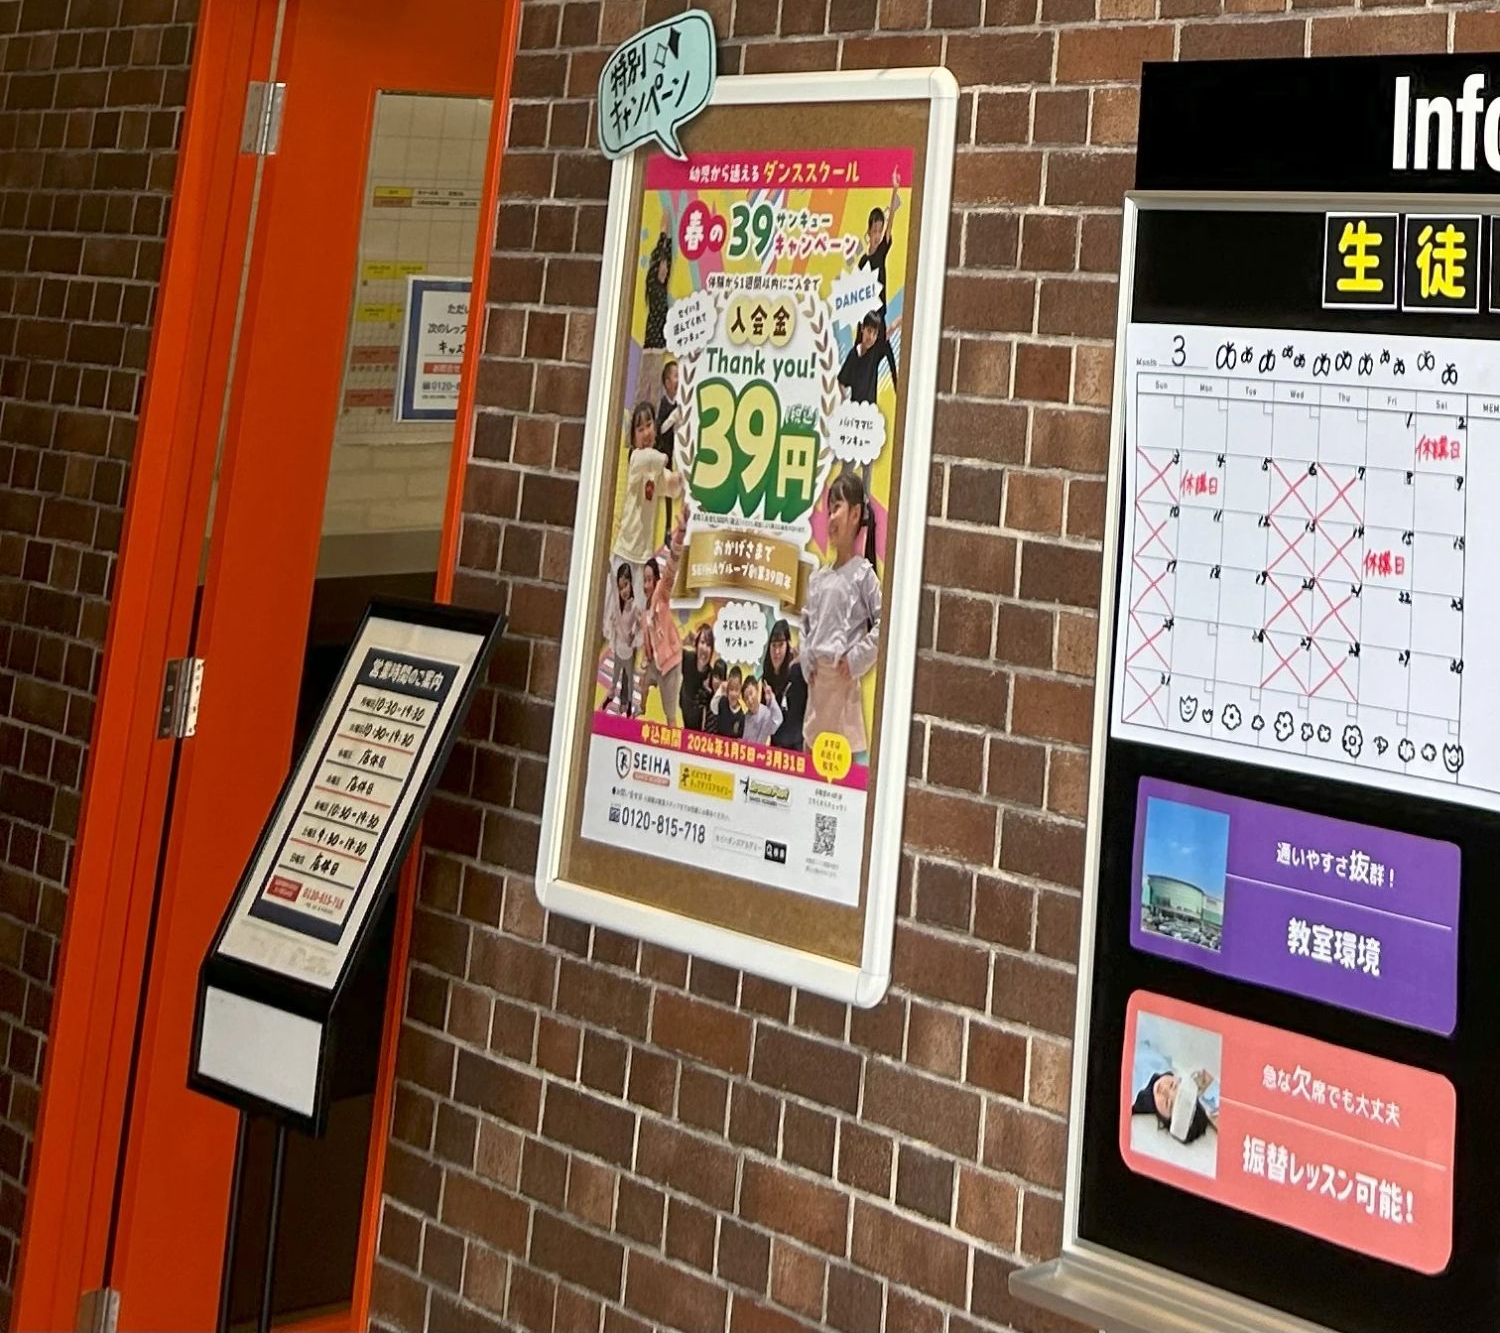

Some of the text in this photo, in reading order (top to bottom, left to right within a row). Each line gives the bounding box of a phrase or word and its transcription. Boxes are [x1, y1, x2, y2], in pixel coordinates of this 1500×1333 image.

[610, 42, 647, 99] 特別
[609, 70, 691, 141] キャンペーン
[762, 160, 860, 184] ダンススクール
[728, 204, 774, 258] 39
[773, 235, 858, 257] キャンペーン
[835, 284, 876, 311] DANCE!
[730, 304, 791, 337] 入会金
[706, 347, 817, 383] Thank you!
[1171, 334, 1187, 368] 3
[1457, 416, 1467, 431] 2
[632, 751, 672, 777] SEIHA
[621, 806, 706, 844] 0120-815-718
[1287, 916, 1382, 978] 教室環境
[1262, 1063, 1401, 1129] 急な欠席でも大丈夫
